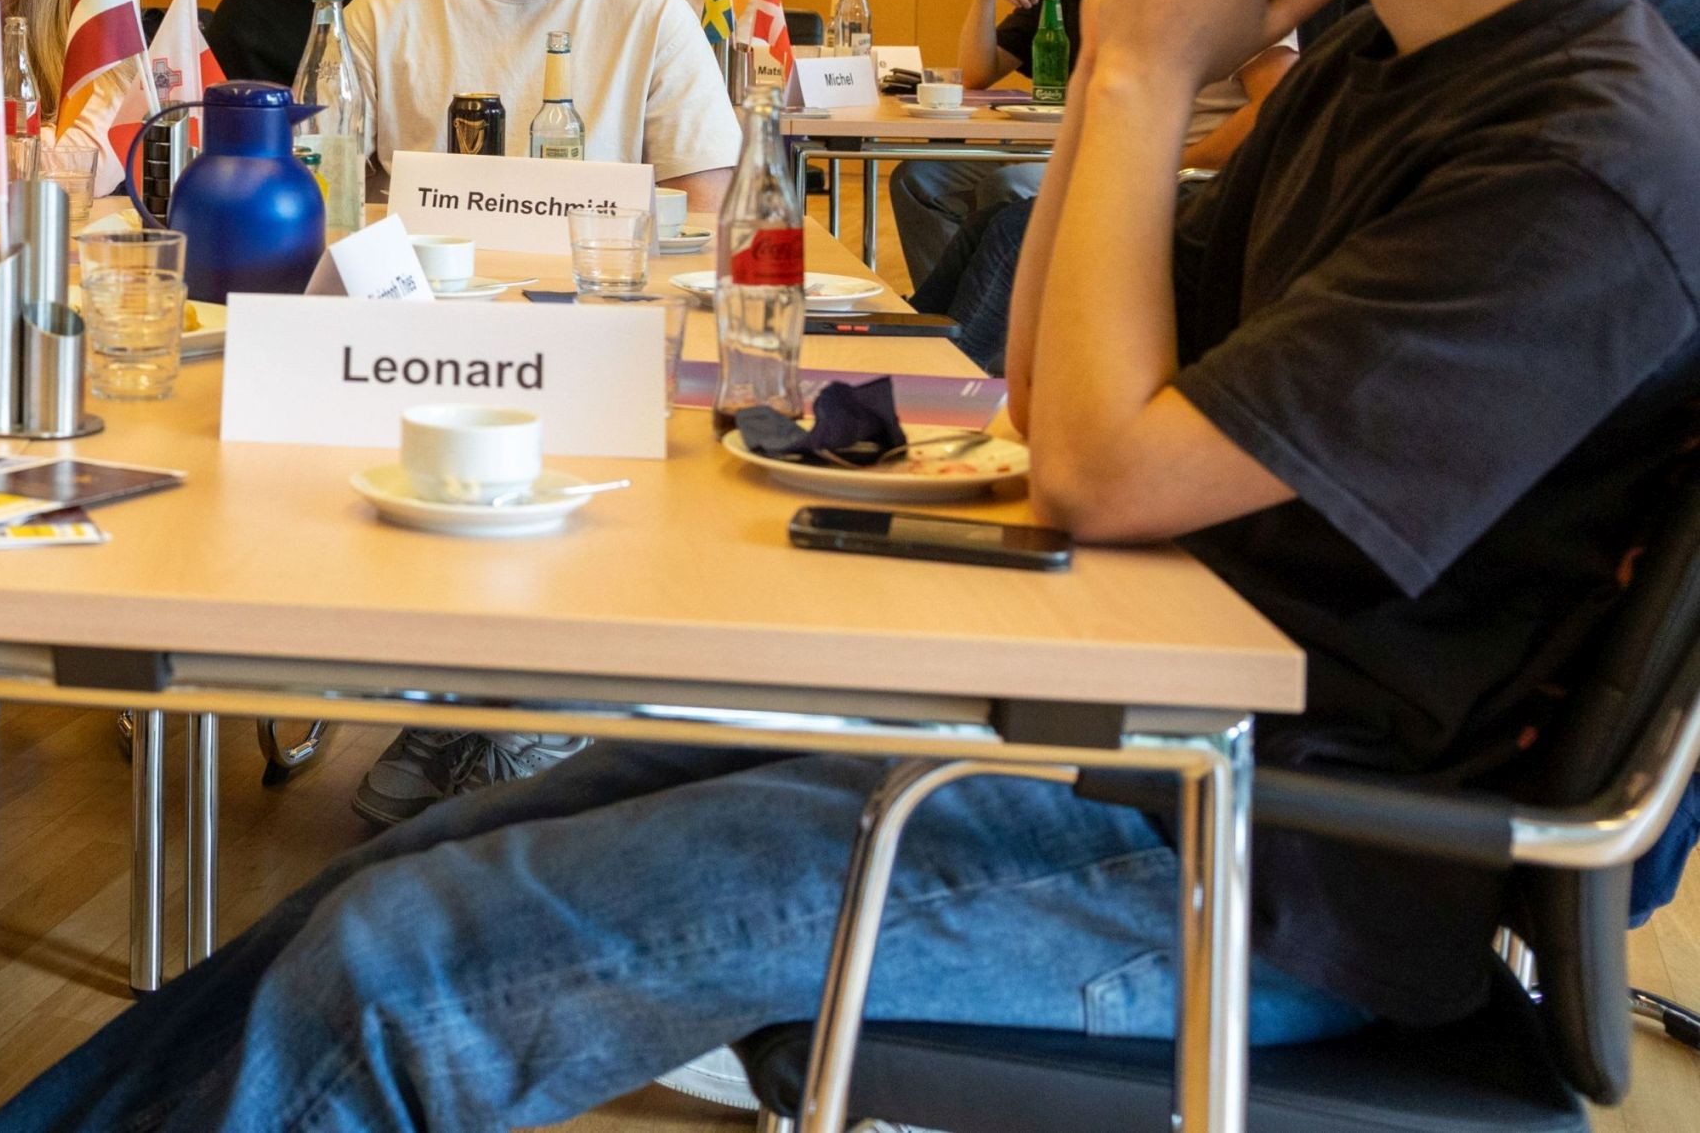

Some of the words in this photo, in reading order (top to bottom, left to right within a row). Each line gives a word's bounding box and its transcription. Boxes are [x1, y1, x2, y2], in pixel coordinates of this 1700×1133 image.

[824, 72, 854, 86] Michel
[418, 186, 459, 209] Tim
[342, 345, 544, 390] Leonard
